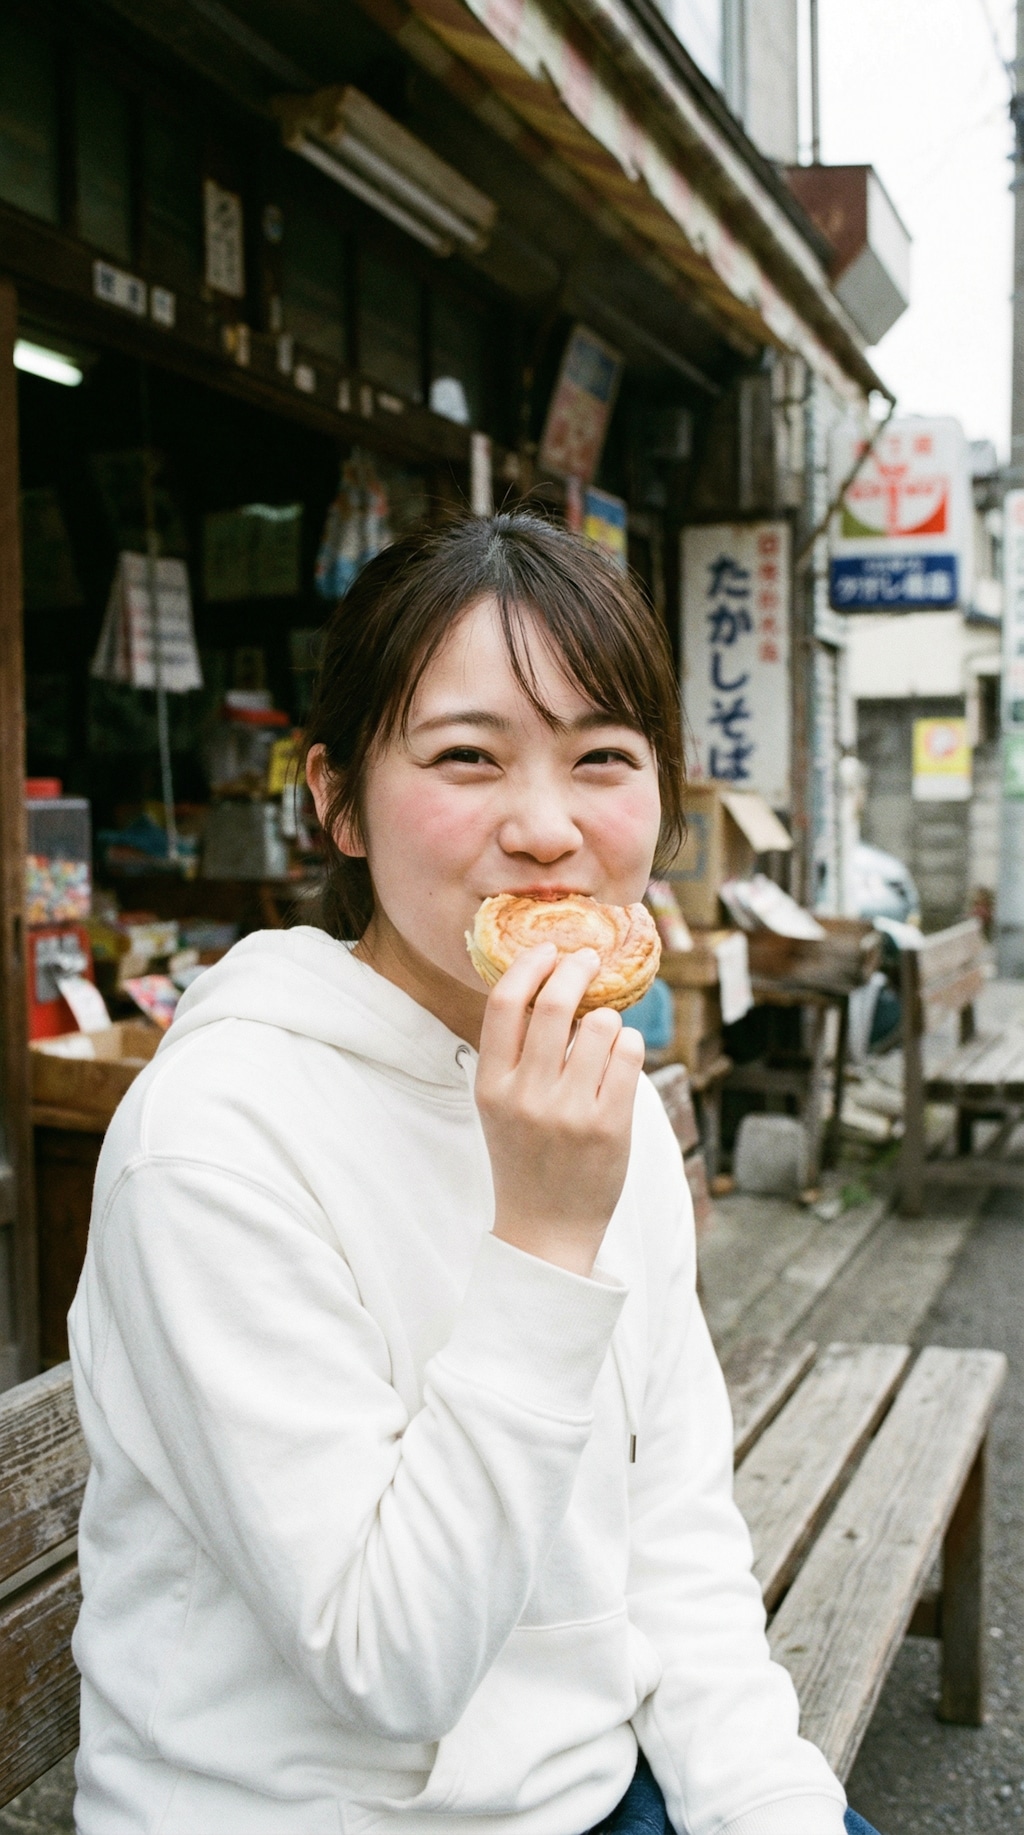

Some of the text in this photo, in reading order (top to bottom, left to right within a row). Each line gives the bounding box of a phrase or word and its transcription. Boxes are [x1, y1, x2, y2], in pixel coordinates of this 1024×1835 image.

[707, 555, 754, 781] たがしそば
